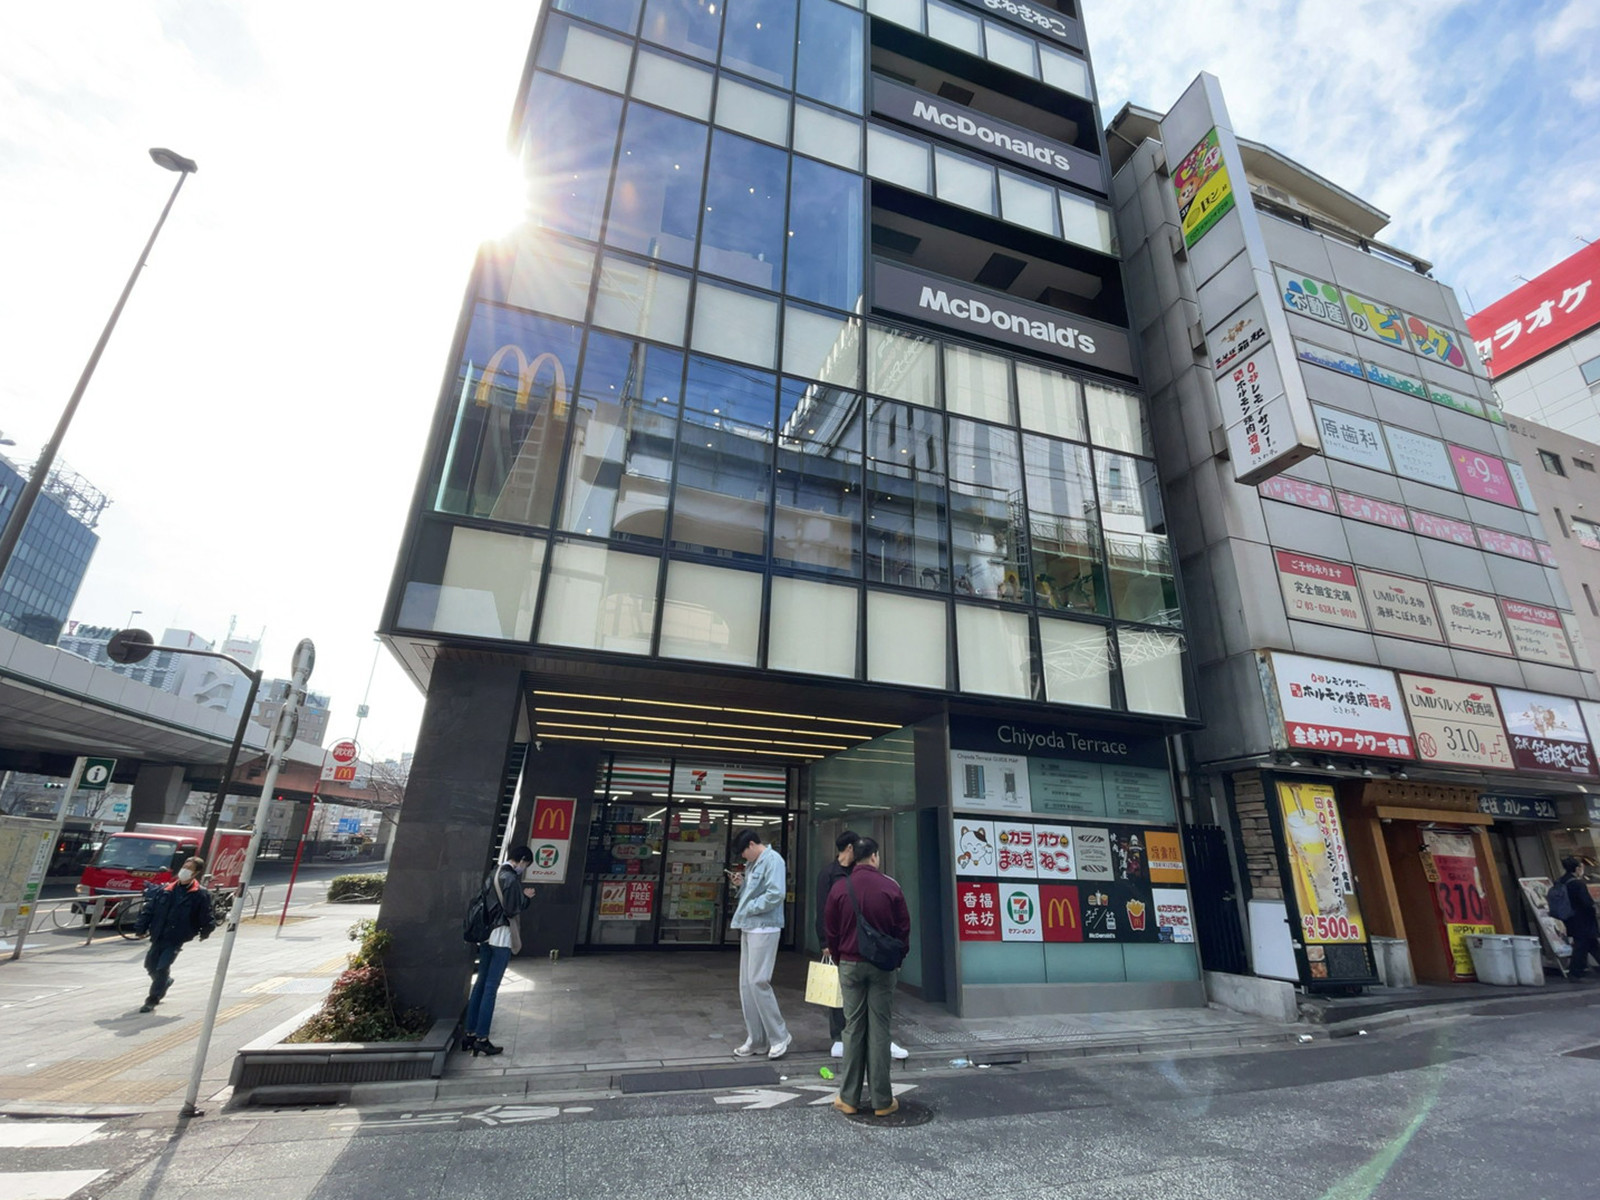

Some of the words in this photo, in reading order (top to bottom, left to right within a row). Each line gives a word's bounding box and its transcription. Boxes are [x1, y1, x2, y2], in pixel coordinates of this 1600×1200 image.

[912, 100, 1071, 171] McDonald's
[918, 286, 1096, 354] McDonald's
[1320, 417, 1378, 450] 原歯科
[1290, 559, 1342, 578] ご予約承ります
[1294, 581, 1352, 603] 完全個室完備
[997, 725, 1065, 751] Chiyoda
[1067, 732, 1128, 754] Terrace
[1443, 726, 1480, 753] 310
[1480, 796, 1500, 814] そば
[1503, 798, 1530, 815] カレー
[1009, 831, 1060, 847] カラオケ
[999, 849, 1072, 875] まねきねこ
[630, 891, 651, 901] FREE
[963, 892, 993, 908] 香福
[1439, 883, 1484, 921] 310
[964, 911, 995, 926] 味坊
[1316, 916, 1359, 939] 500円
